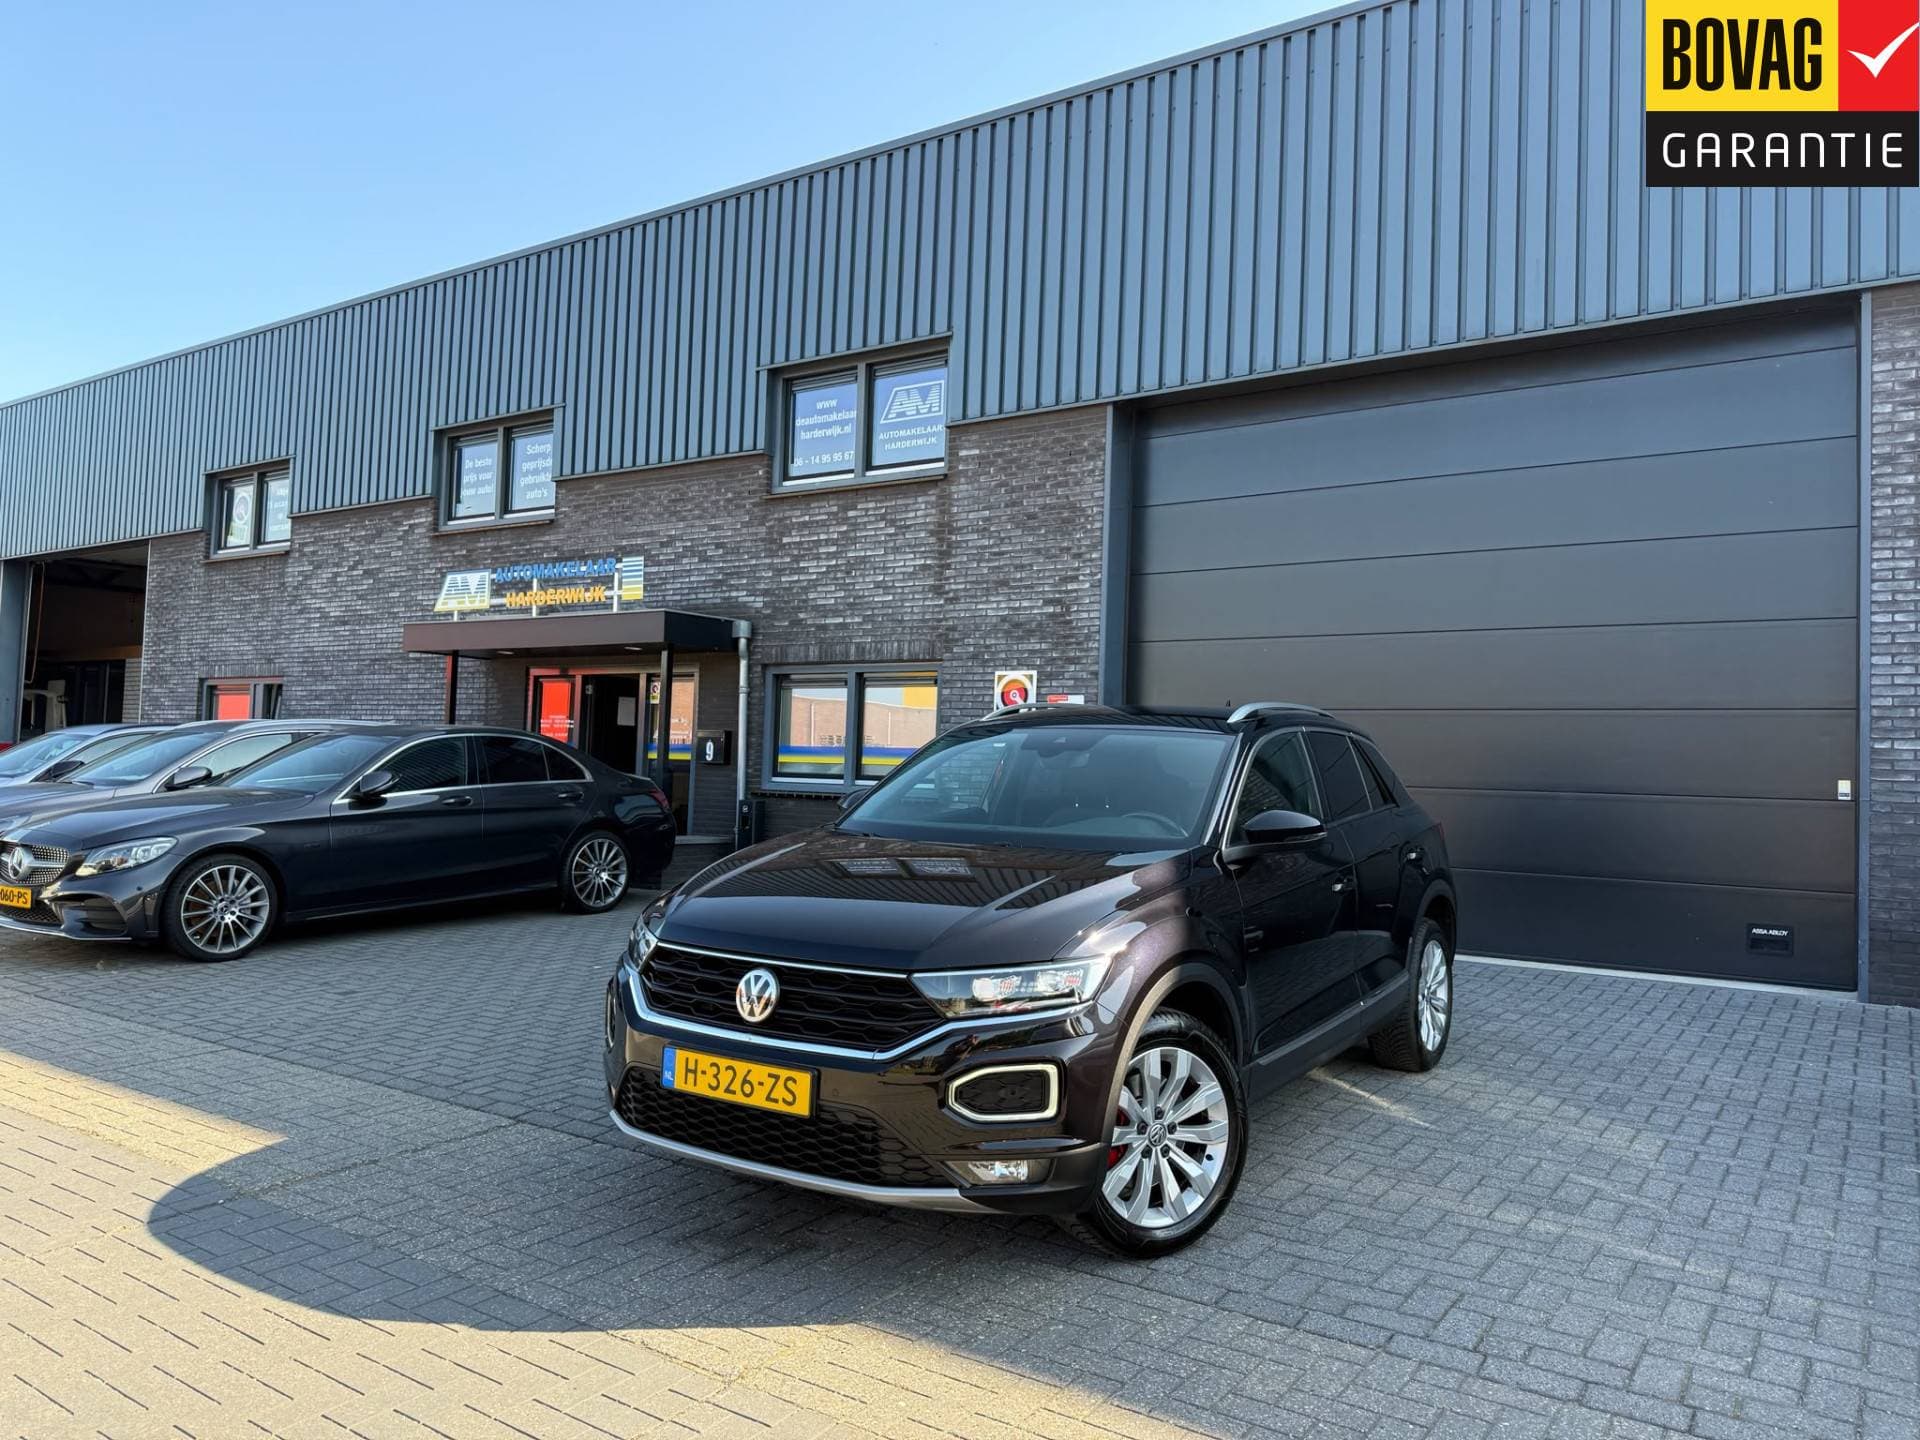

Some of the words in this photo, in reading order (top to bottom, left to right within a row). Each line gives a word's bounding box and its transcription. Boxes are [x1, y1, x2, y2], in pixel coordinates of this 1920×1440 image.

[816, 399, 838, 410] www
[800, 422, 852, 440] harderwijk.nl
[879, 423, 945, 441] AUTOMAKELAAR
[526, 443, 552, 455] Scherp
[884, 436, 937, 451] HARDERWIJK
[494, 557, 617, 583] AUTOMAKELAAR
[505, 585, 606, 608] HARDERWIJK
[705, 740, 714, 761] 9
[683, 1056, 798, 1107] H-326-ZS
